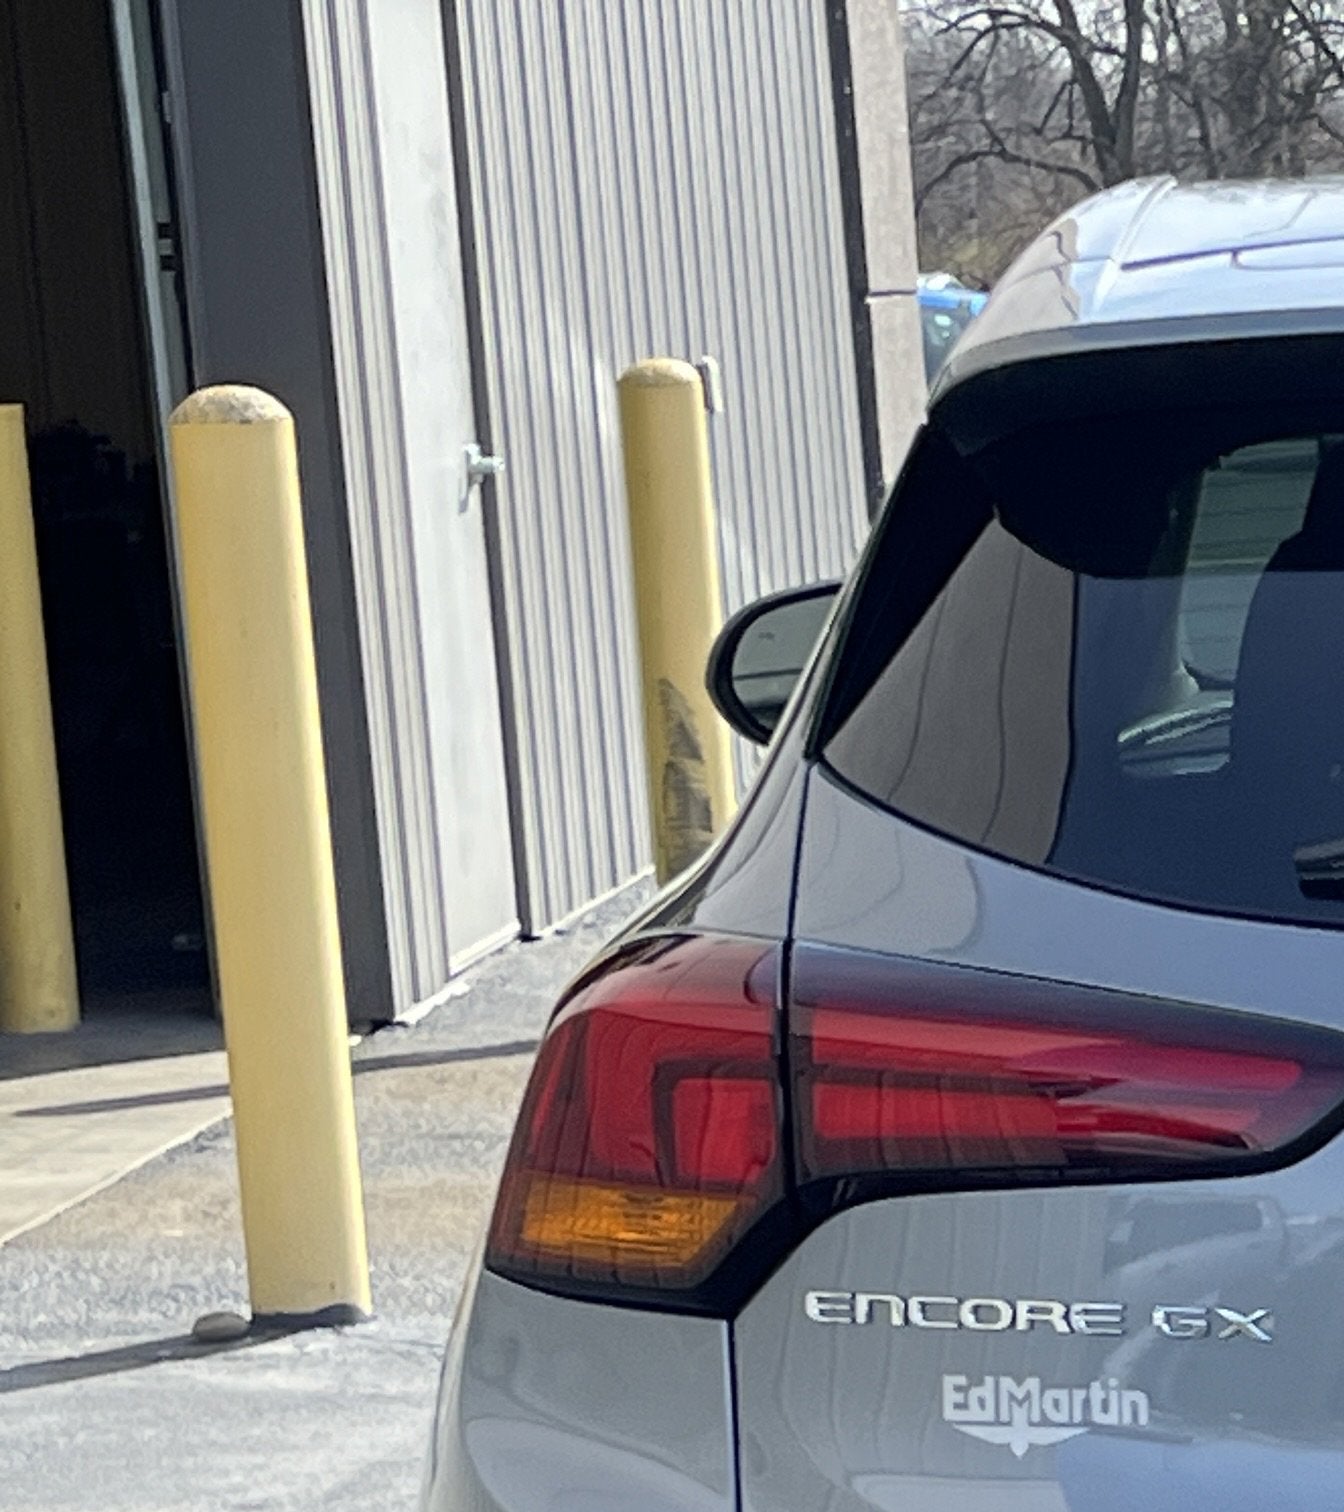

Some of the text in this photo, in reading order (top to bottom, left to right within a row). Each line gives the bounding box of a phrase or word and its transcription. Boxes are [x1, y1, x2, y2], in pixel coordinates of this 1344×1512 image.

[804, 1290, 1275, 1343] ENCORE GX
[942, 1374, 1149, 1426] EdMartin
